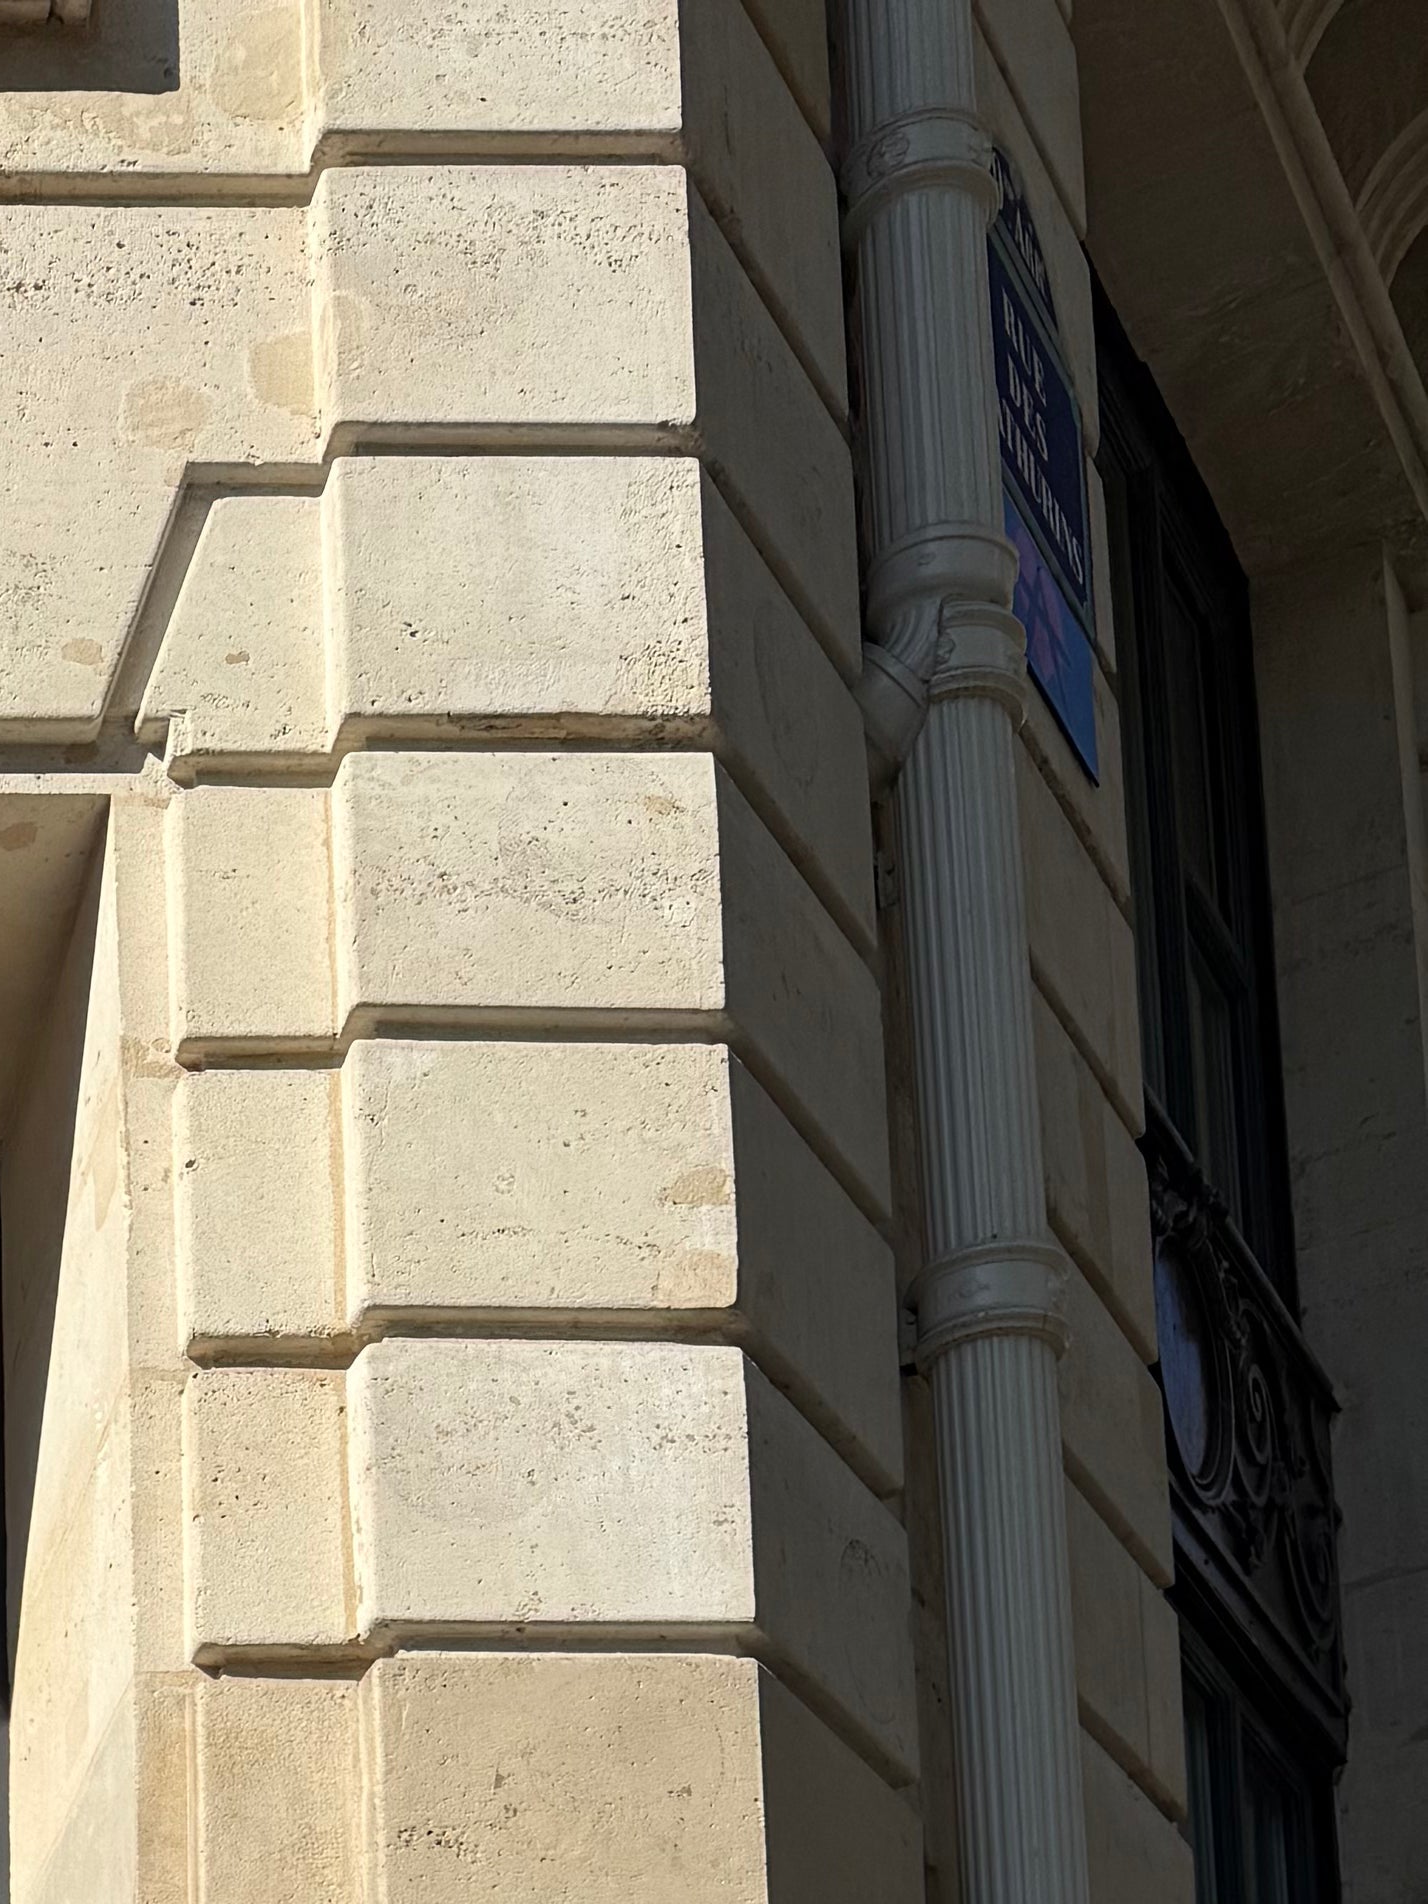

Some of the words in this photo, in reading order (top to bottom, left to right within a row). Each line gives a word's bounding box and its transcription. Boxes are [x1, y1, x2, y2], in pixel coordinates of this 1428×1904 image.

[1001, 286, 1048, 408] RUE
[1007, 353, 1050, 463] DES
[998, 395, 1085, 586] THURINS
